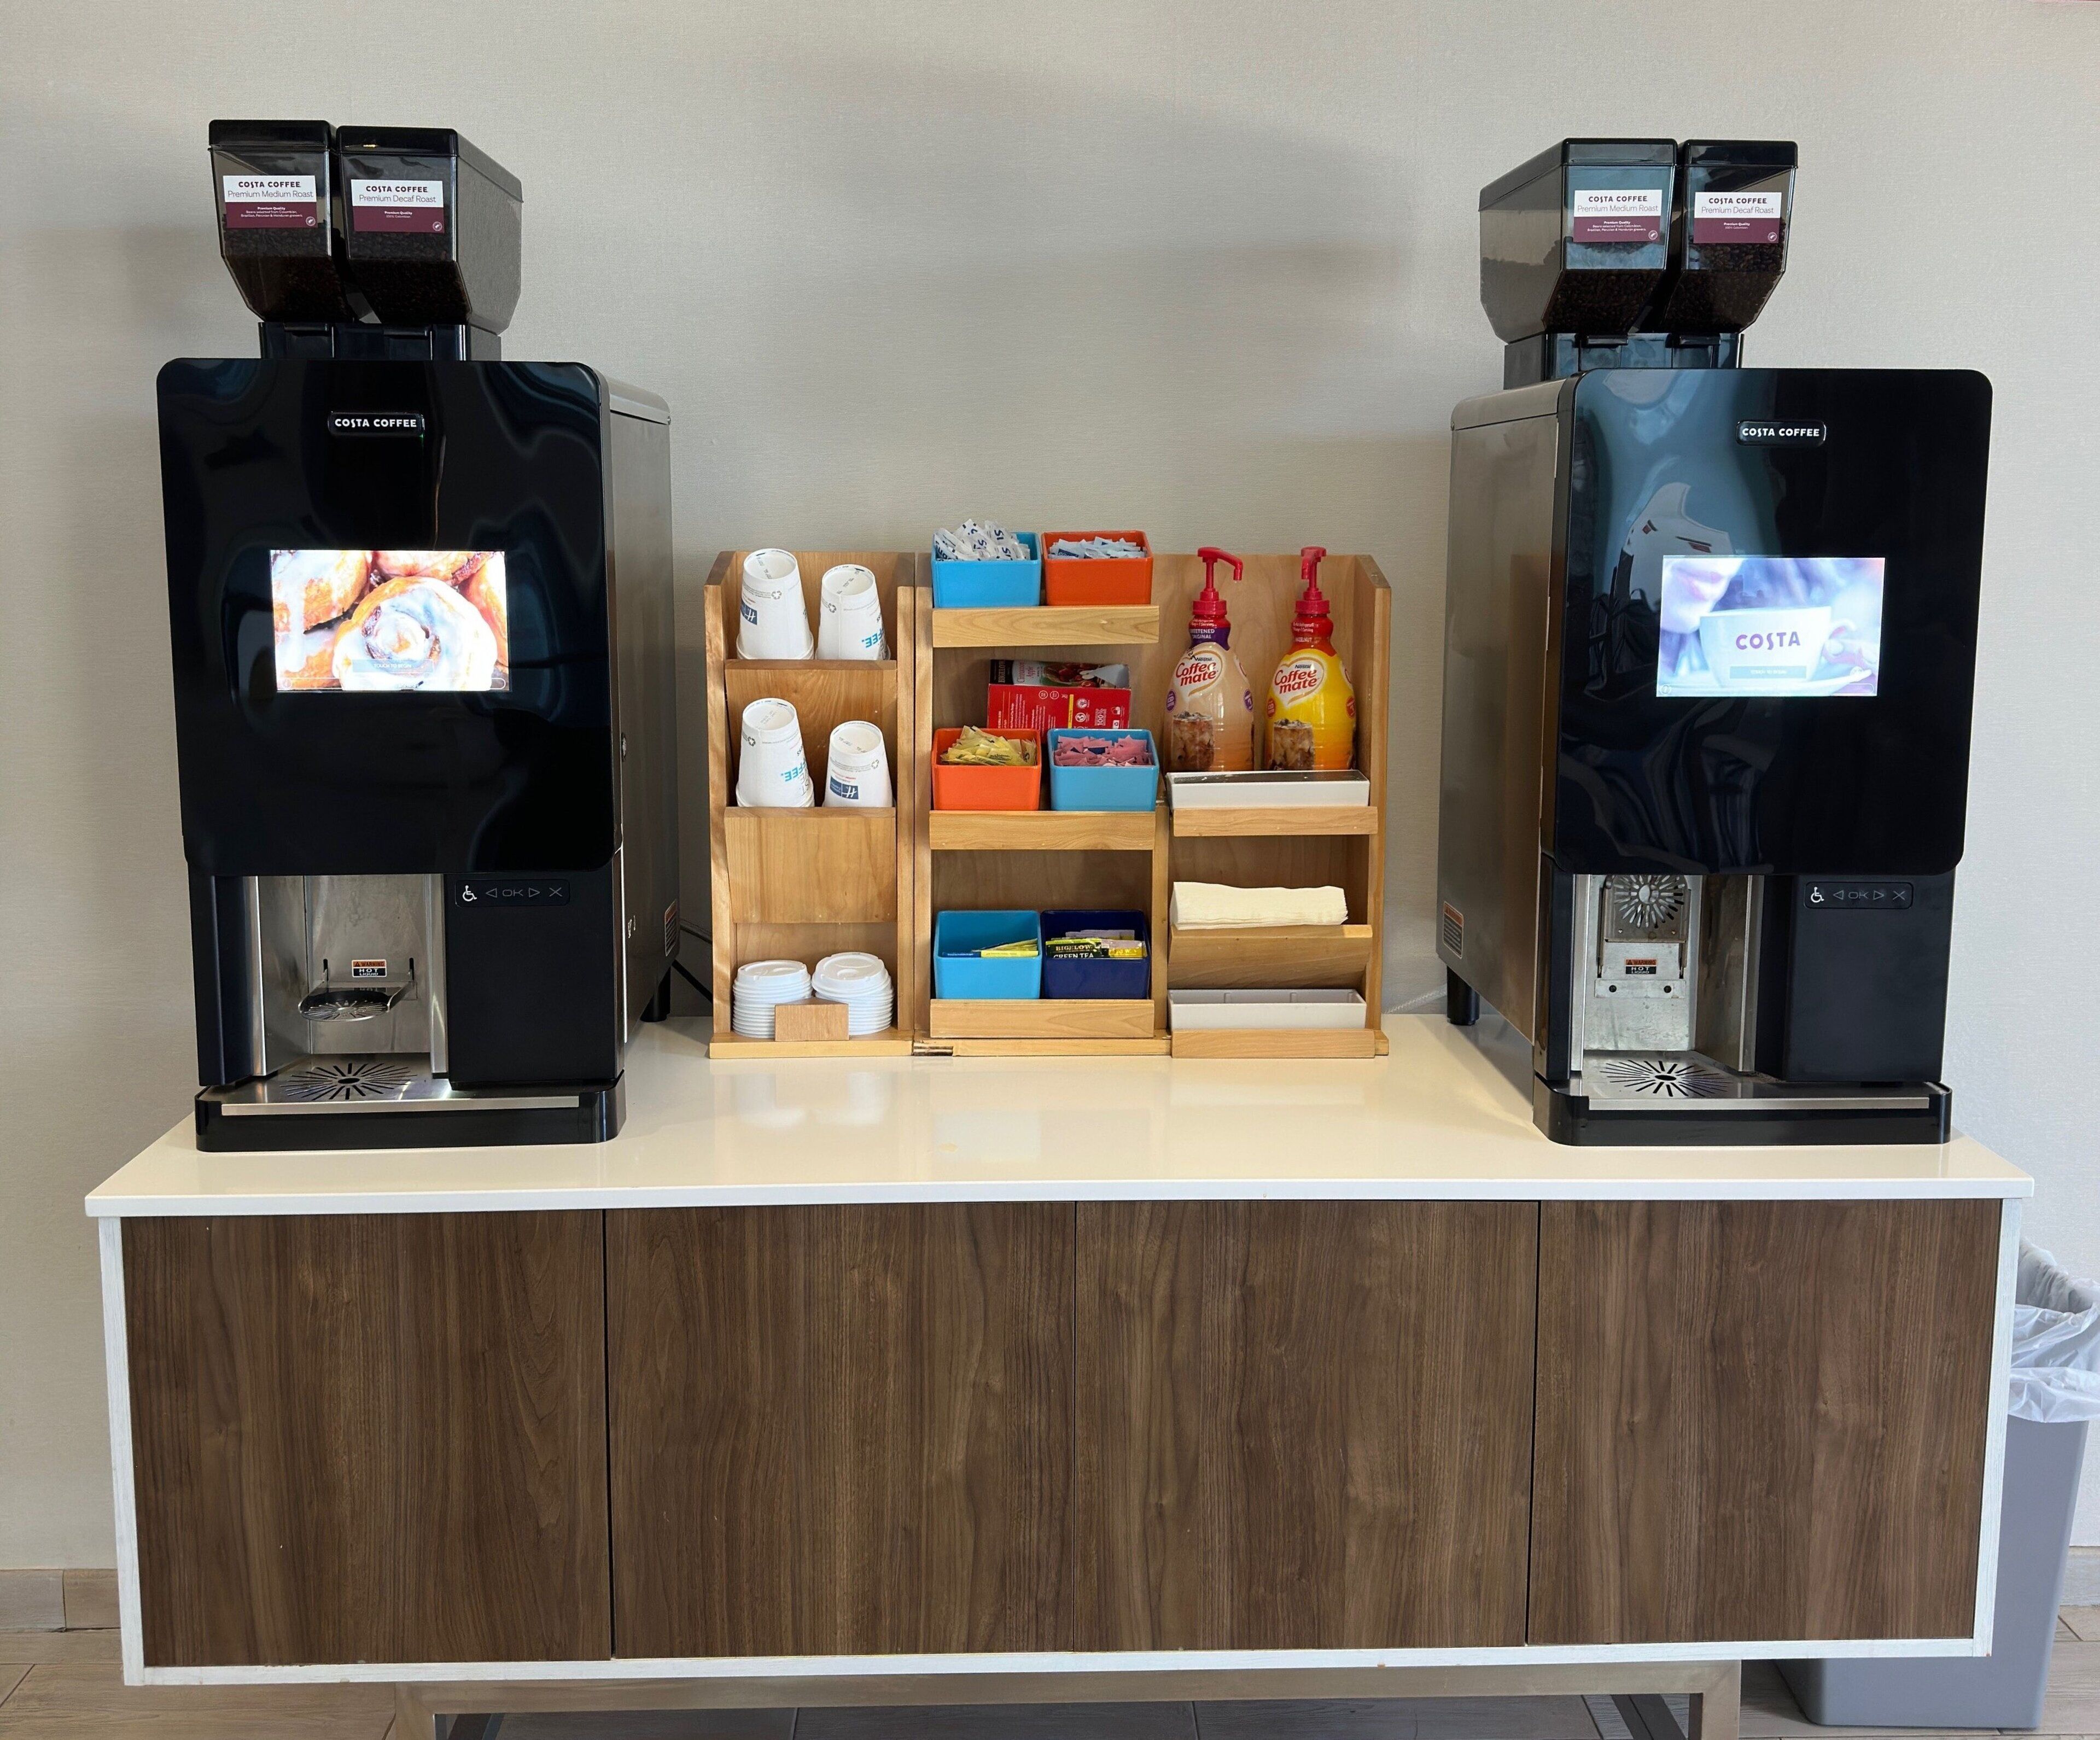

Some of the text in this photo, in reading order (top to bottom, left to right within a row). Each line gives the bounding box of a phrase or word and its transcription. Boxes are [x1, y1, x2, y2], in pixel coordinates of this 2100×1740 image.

[335, 419, 417, 428] COSTA COFFEE
[1742, 428, 1820, 437] COSTA COFFEE
[1736, 631, 1800, 651] COSTA
[1176, 662, 1216, 678] Coffee
[1181, 670, 1217, 686] mate
[1274, 669, 1317, 685] Coffee
[1279, 678, 1317, 694] mate
